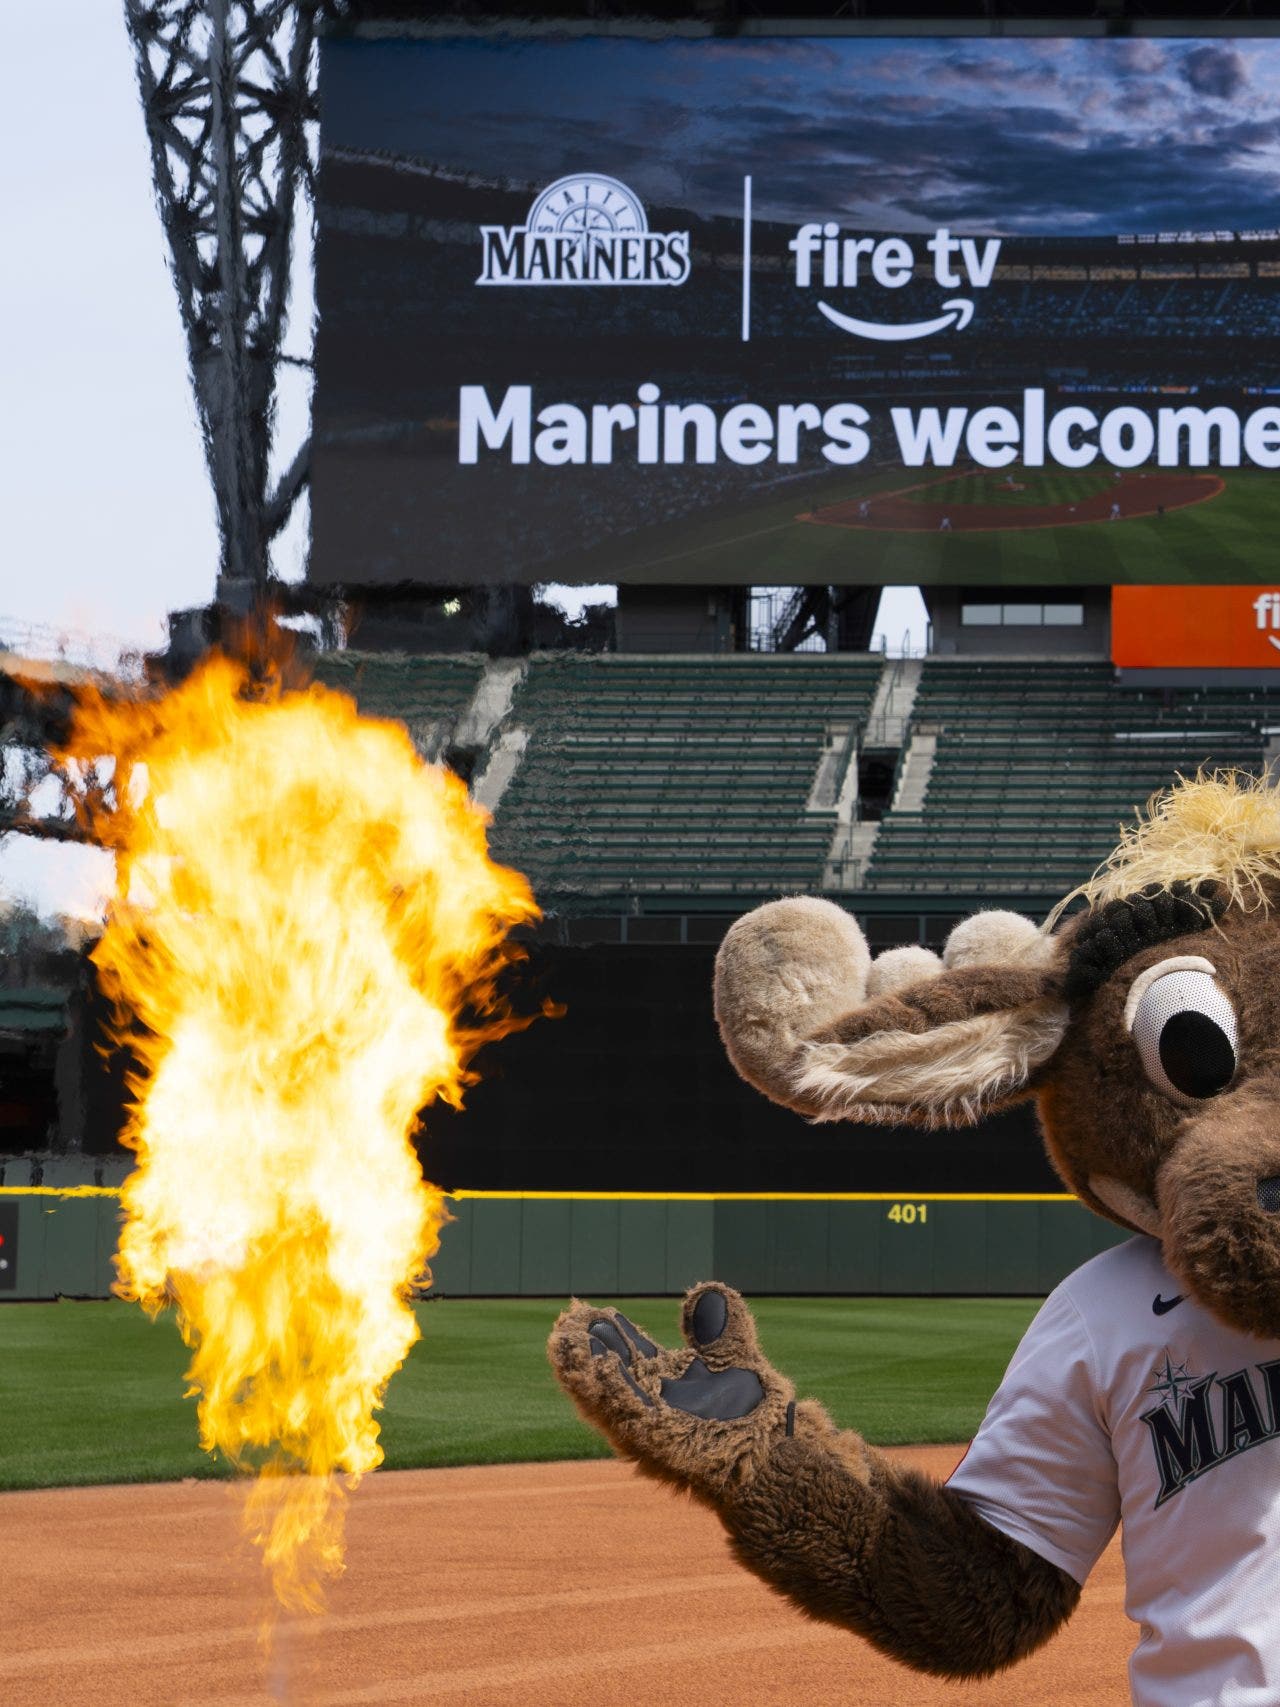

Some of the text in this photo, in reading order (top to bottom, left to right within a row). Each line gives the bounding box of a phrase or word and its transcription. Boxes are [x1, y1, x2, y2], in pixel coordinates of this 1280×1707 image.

[537, 185, 637, 233] SEATTLE
[476, 226, 690, 285] MARINERS
[789, 222, 1002, 288] fire tv
[458, 382, 871, 465] Mariners
[888, 1203, 927, 1223] 401
